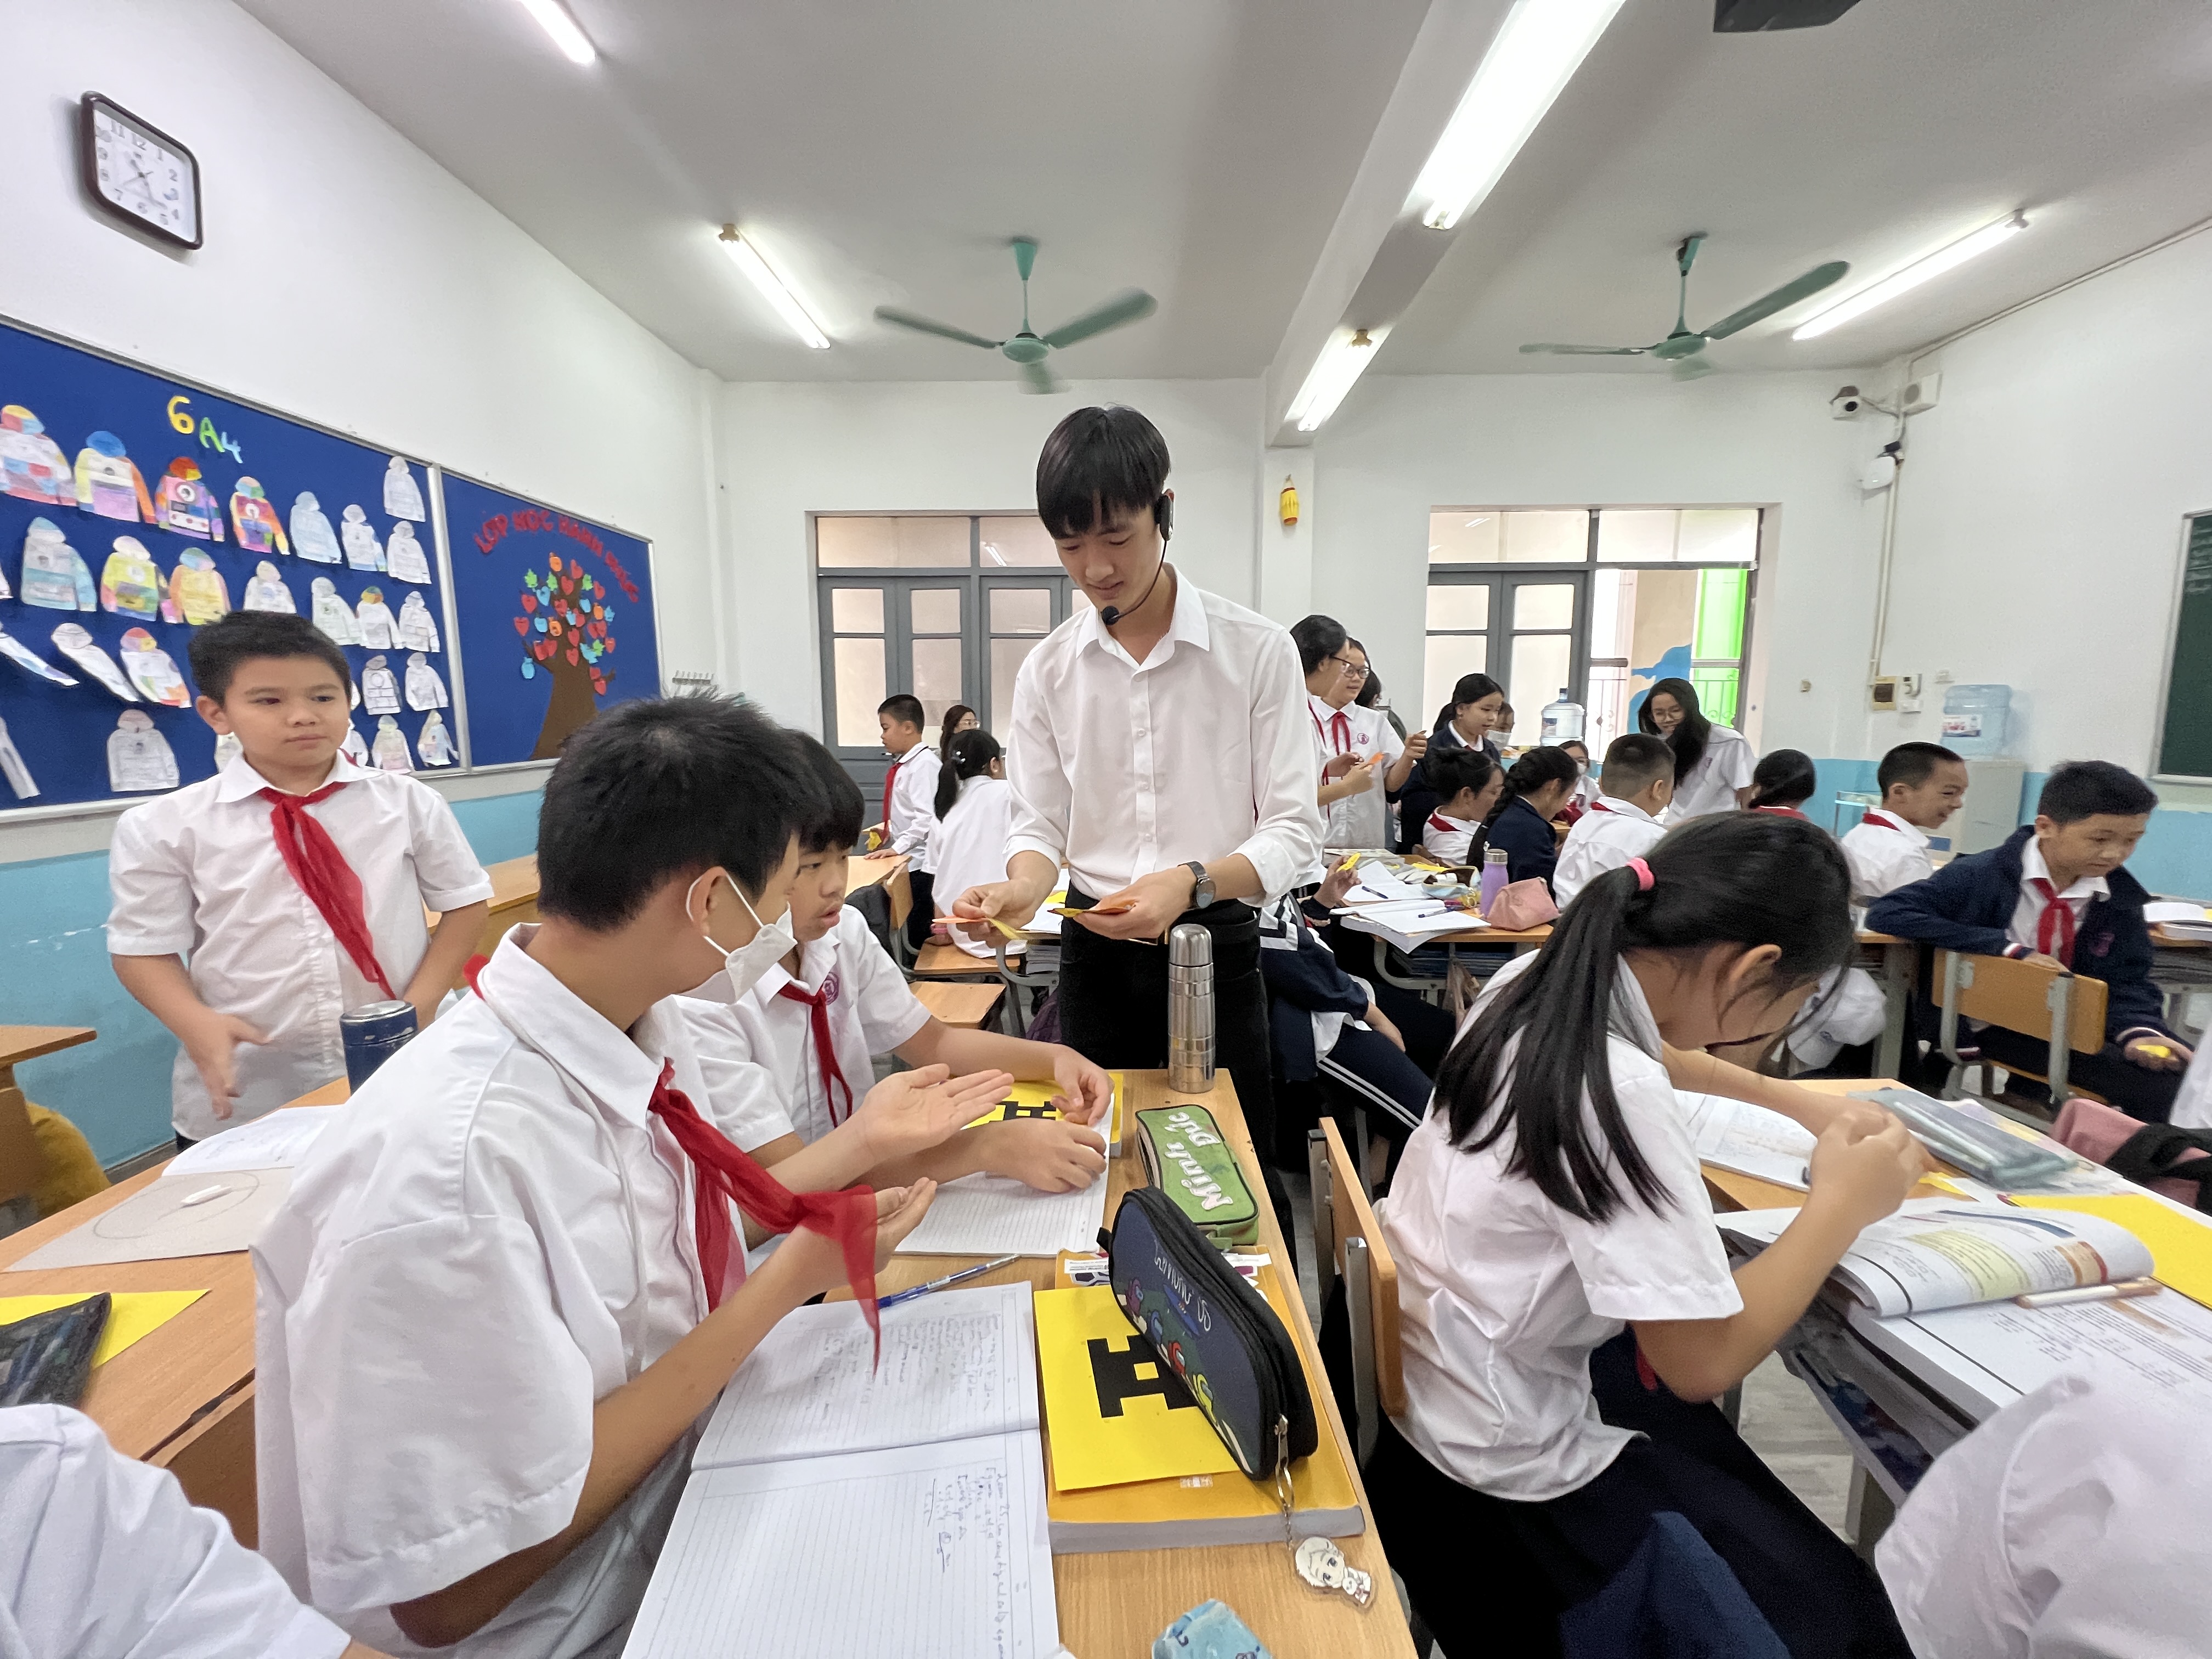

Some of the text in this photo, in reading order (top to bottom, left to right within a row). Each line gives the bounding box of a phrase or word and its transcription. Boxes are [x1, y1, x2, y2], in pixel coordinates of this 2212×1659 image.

[114, 188, 123, 201] 7
[168, 168, 178, 182] 2
[167, 395, 244, 464] 6A4
[1164, 1142, 1234, 1211] Minh
